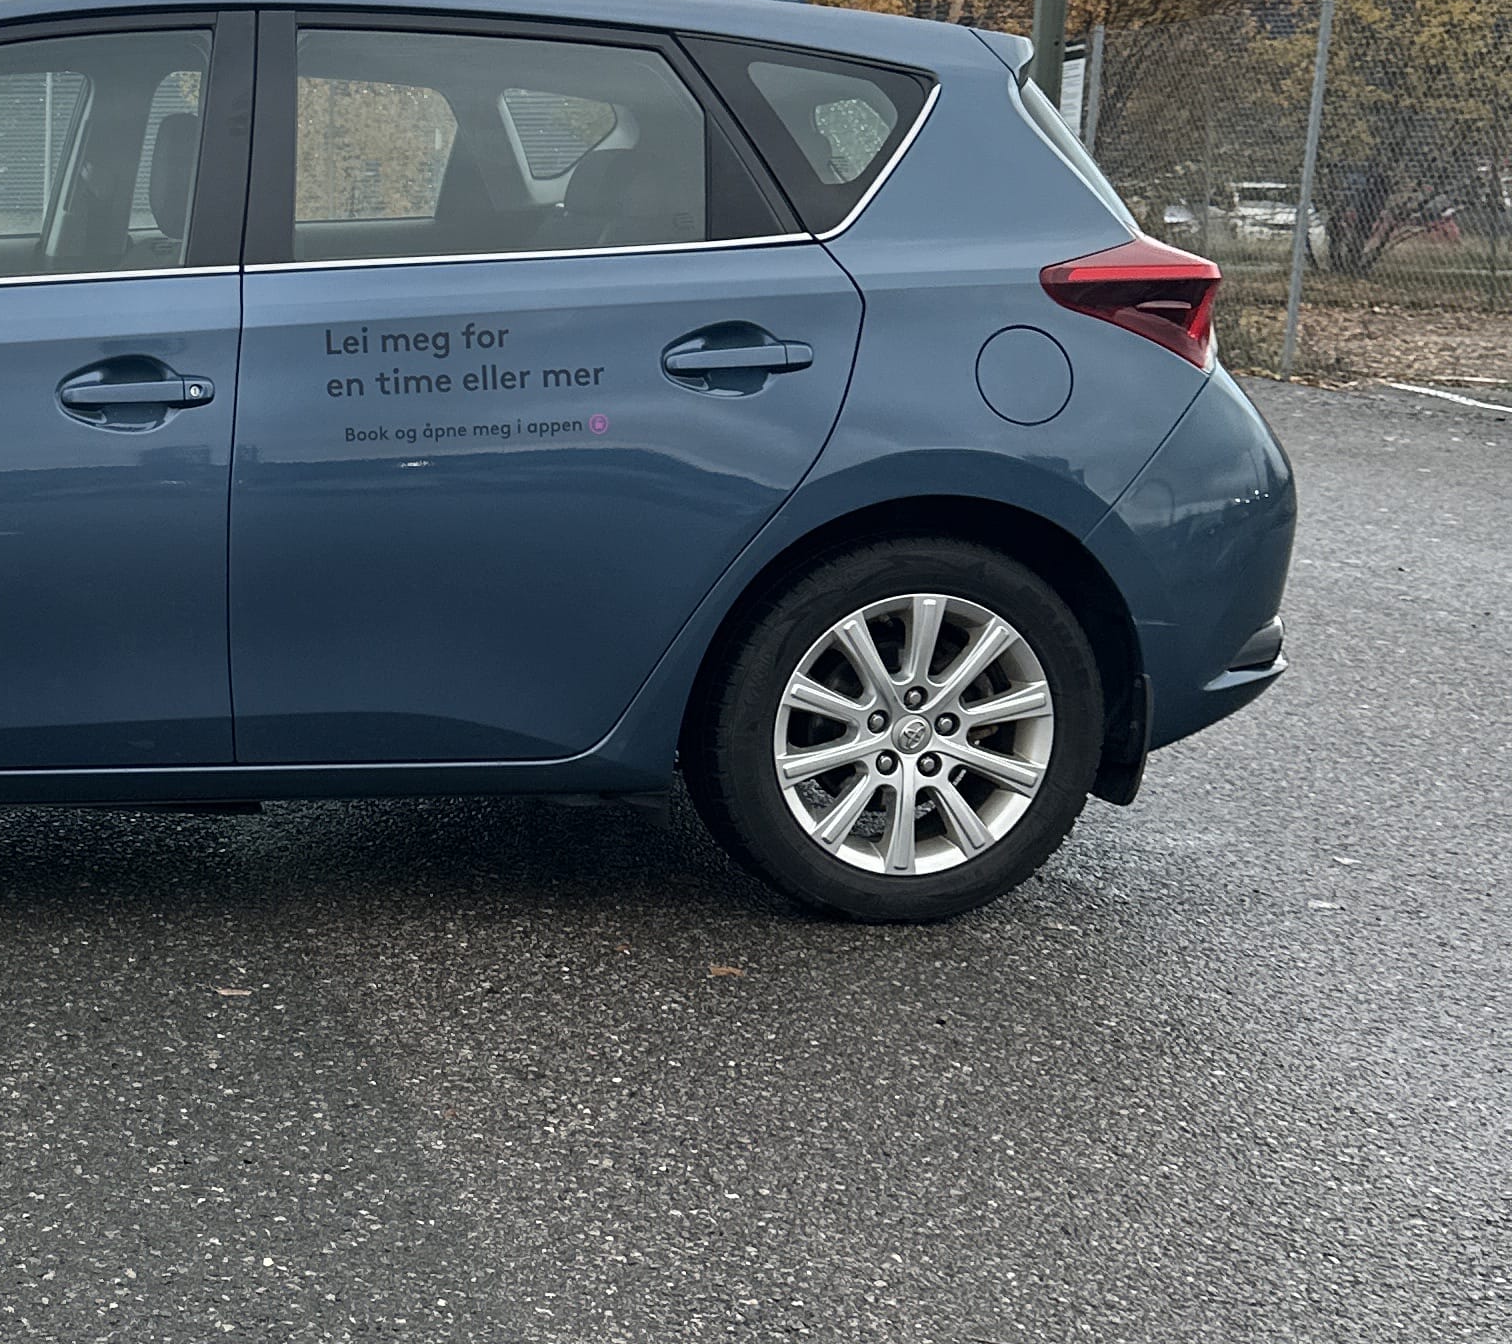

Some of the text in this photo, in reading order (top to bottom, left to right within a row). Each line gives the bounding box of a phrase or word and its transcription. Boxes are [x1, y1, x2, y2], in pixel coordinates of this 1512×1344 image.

[325, 323, 509, 358] Lei meg for
[327, 365, 605, 397] en time eller mer
[345, 425, 388, 442] Book
[395, 426, 417, 443] og
[423, 422, 467, 442] åpne
[473, 423, 511, 439] meg
[527, 419, 583, 436] appen
